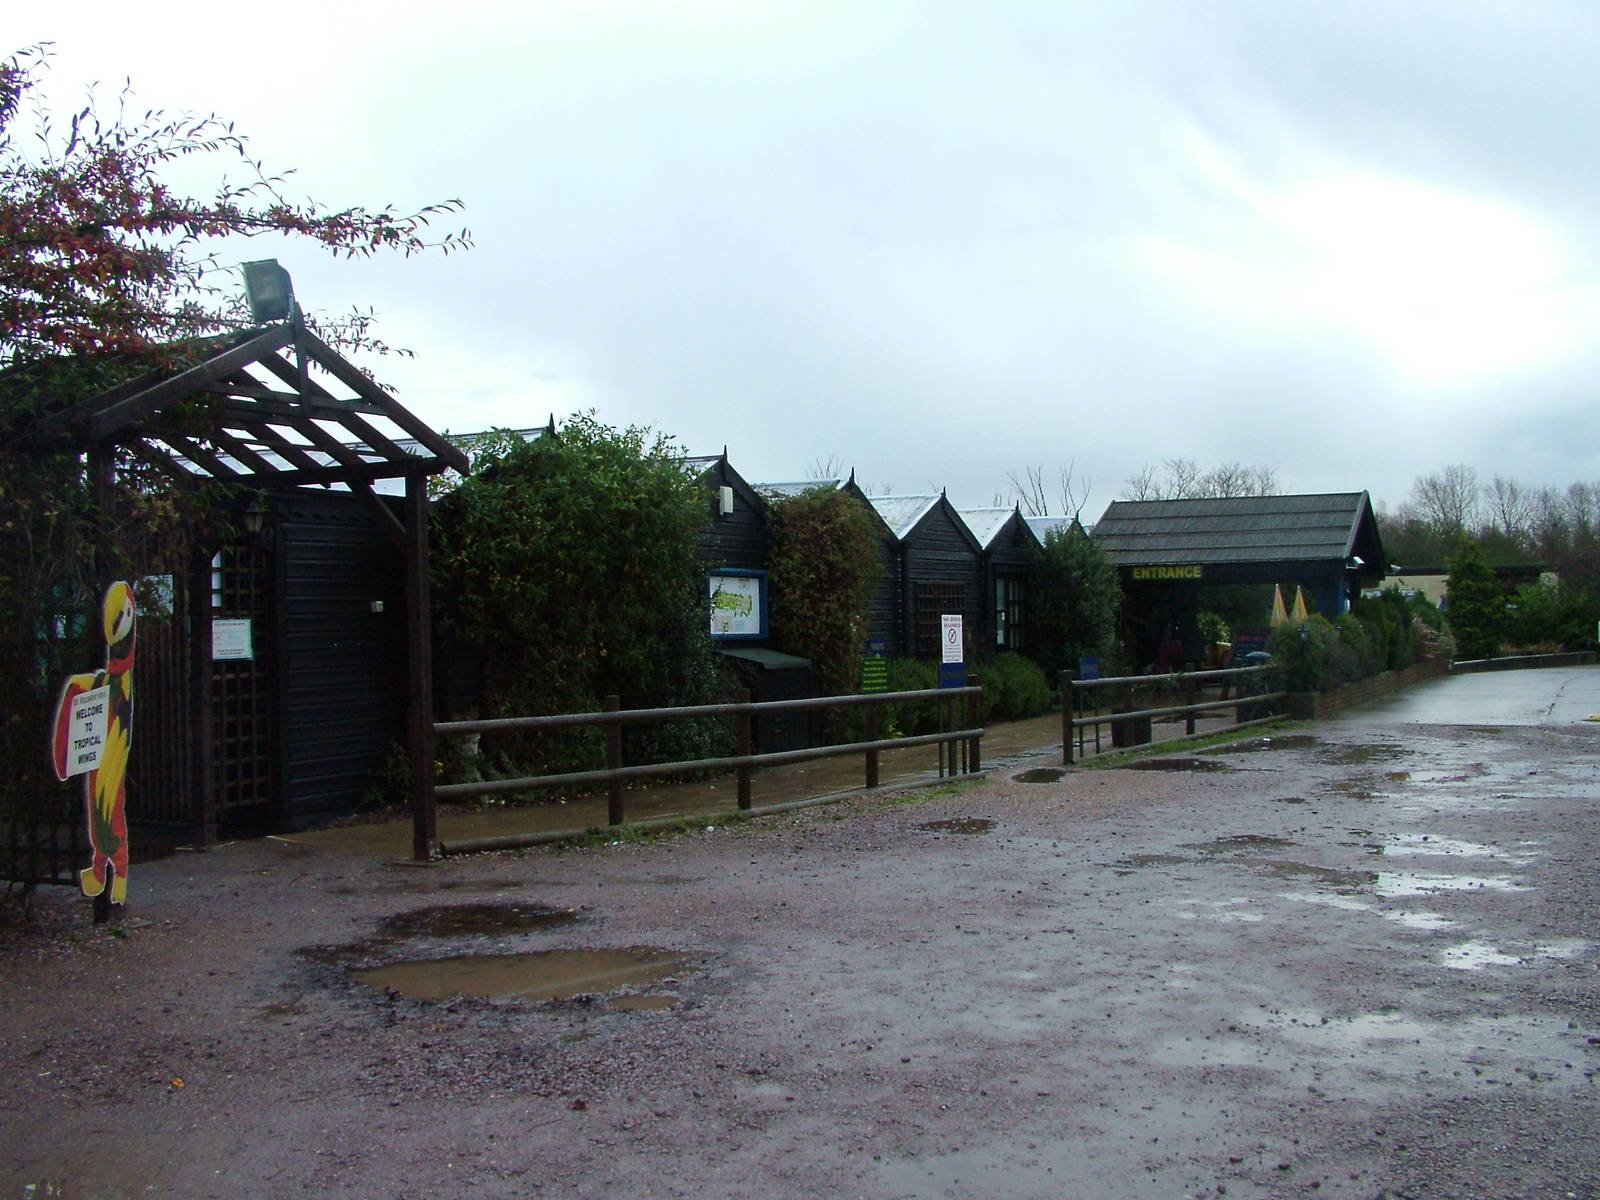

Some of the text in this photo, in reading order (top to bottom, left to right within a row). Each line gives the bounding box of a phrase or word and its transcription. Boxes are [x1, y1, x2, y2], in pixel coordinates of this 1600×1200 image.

[1133, 566, 1201, 579] ENTRANCE
[76, 704, 103, 720] WELCOME
[85, 722, 93, 732] TO
[74, 736, 101, 750] TROPICAL
[78, 752, 97, 764] WINGS
